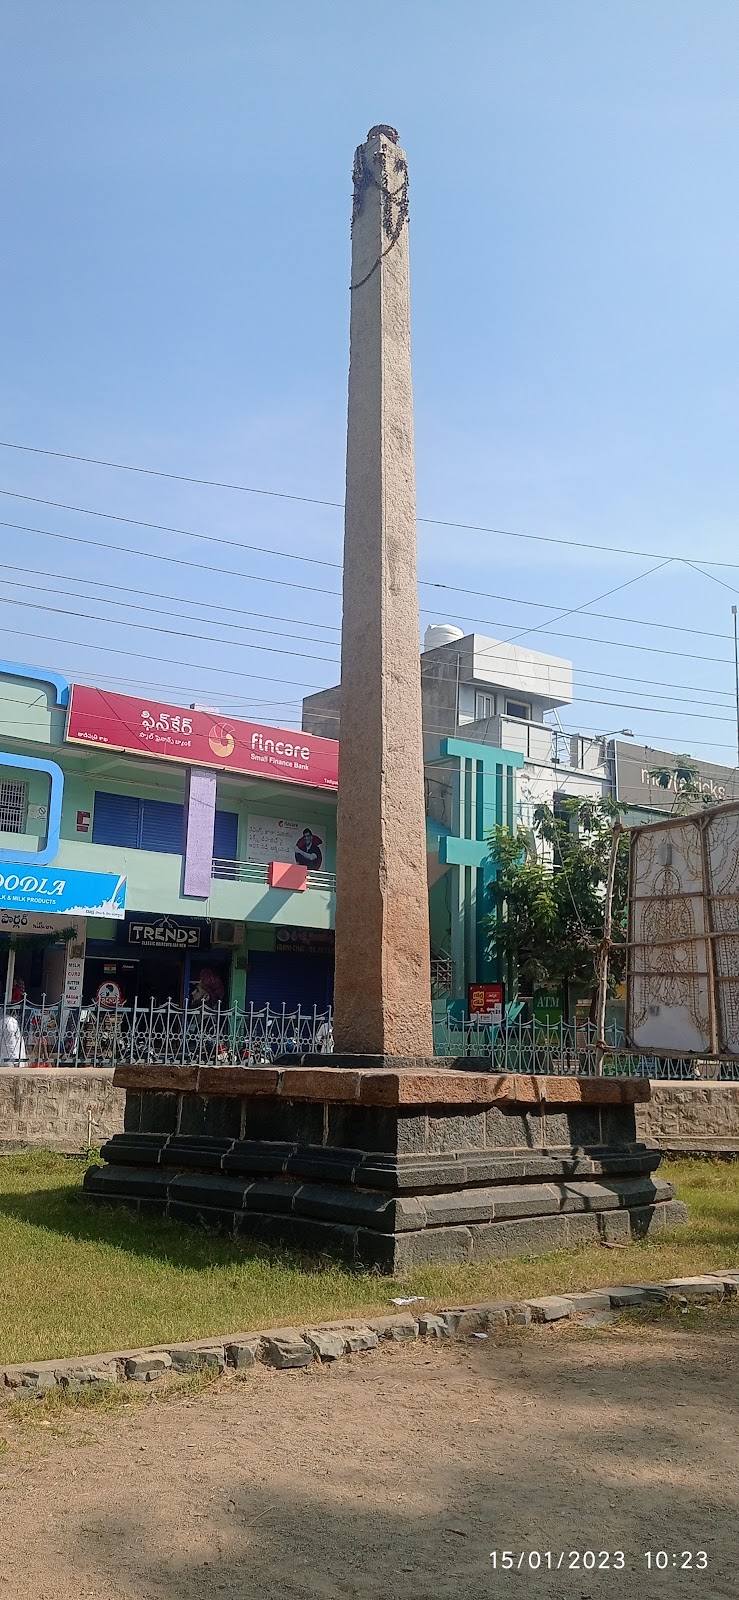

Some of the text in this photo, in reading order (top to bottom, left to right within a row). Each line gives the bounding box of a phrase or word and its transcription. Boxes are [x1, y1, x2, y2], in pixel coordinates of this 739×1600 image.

[251, 732, 310, 760] fincare
[250, 752, 309, 771] Small Finance Bank
[0, 873, 66, 896] ODLA
[132, 925, 198, 943] TRENDS
[537, 996, 560, 1008] ATM
